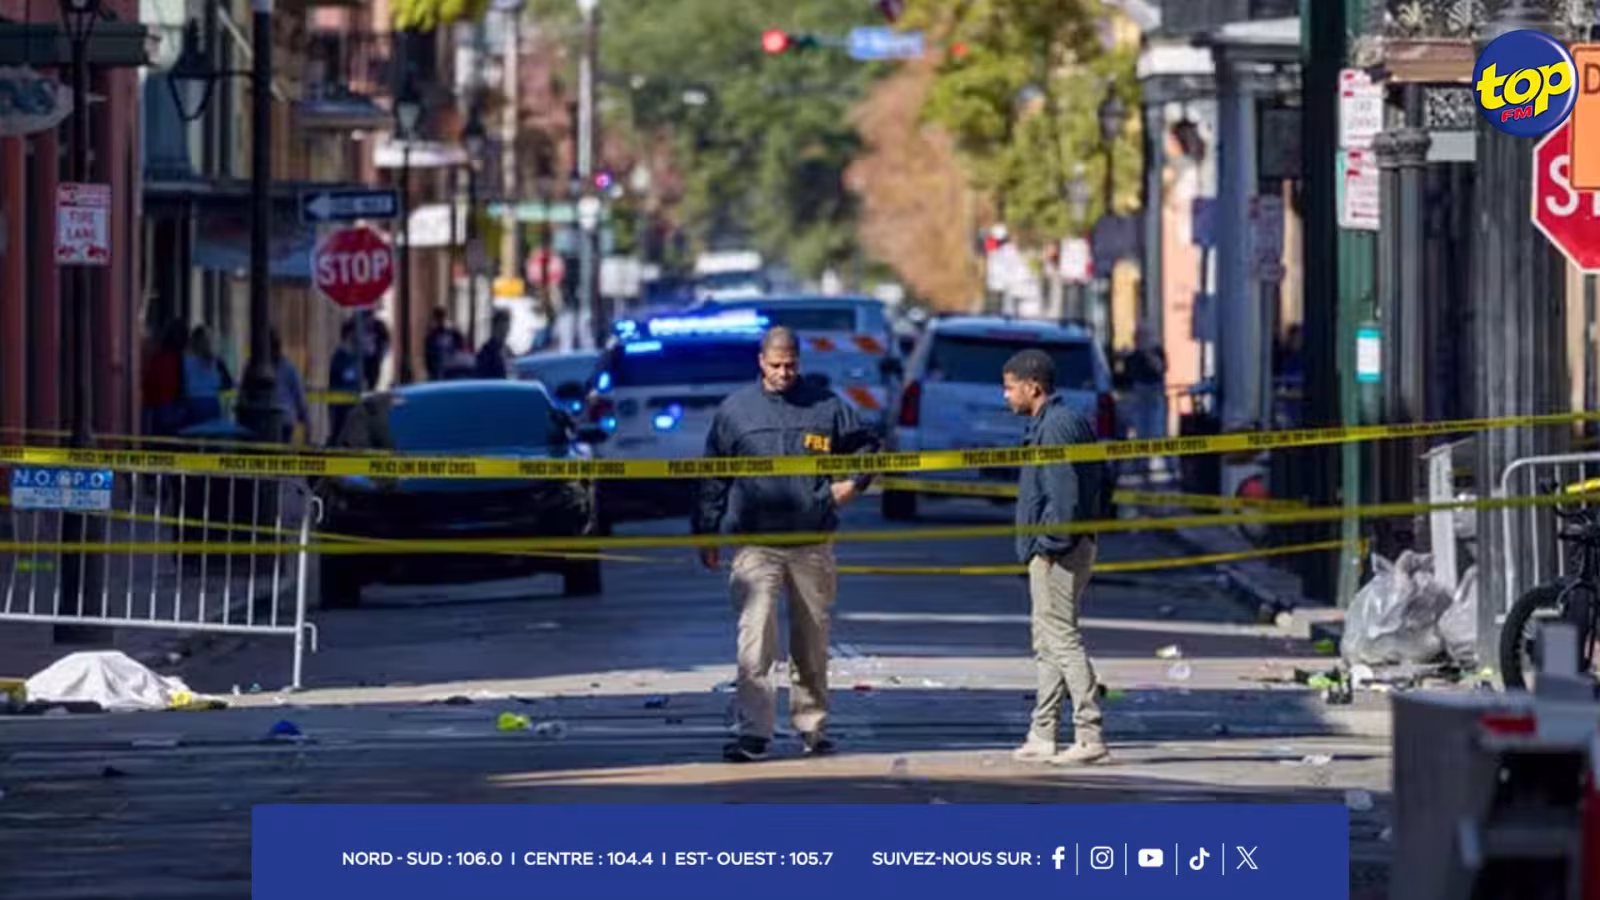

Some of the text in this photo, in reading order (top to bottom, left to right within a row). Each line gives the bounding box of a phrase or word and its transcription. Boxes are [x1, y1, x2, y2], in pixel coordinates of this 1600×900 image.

[318, 249, 389, 286] STOP
[803, 434, 831, 451] FBI
[817, 454, 920, 470] POLICE LINE DO NOT CROSS
[963, 447, 1065, 465] POLICE LINE DO NOT CROSS
[669, 458, 773, 473] POLICE LINE DO NOT CROSS
